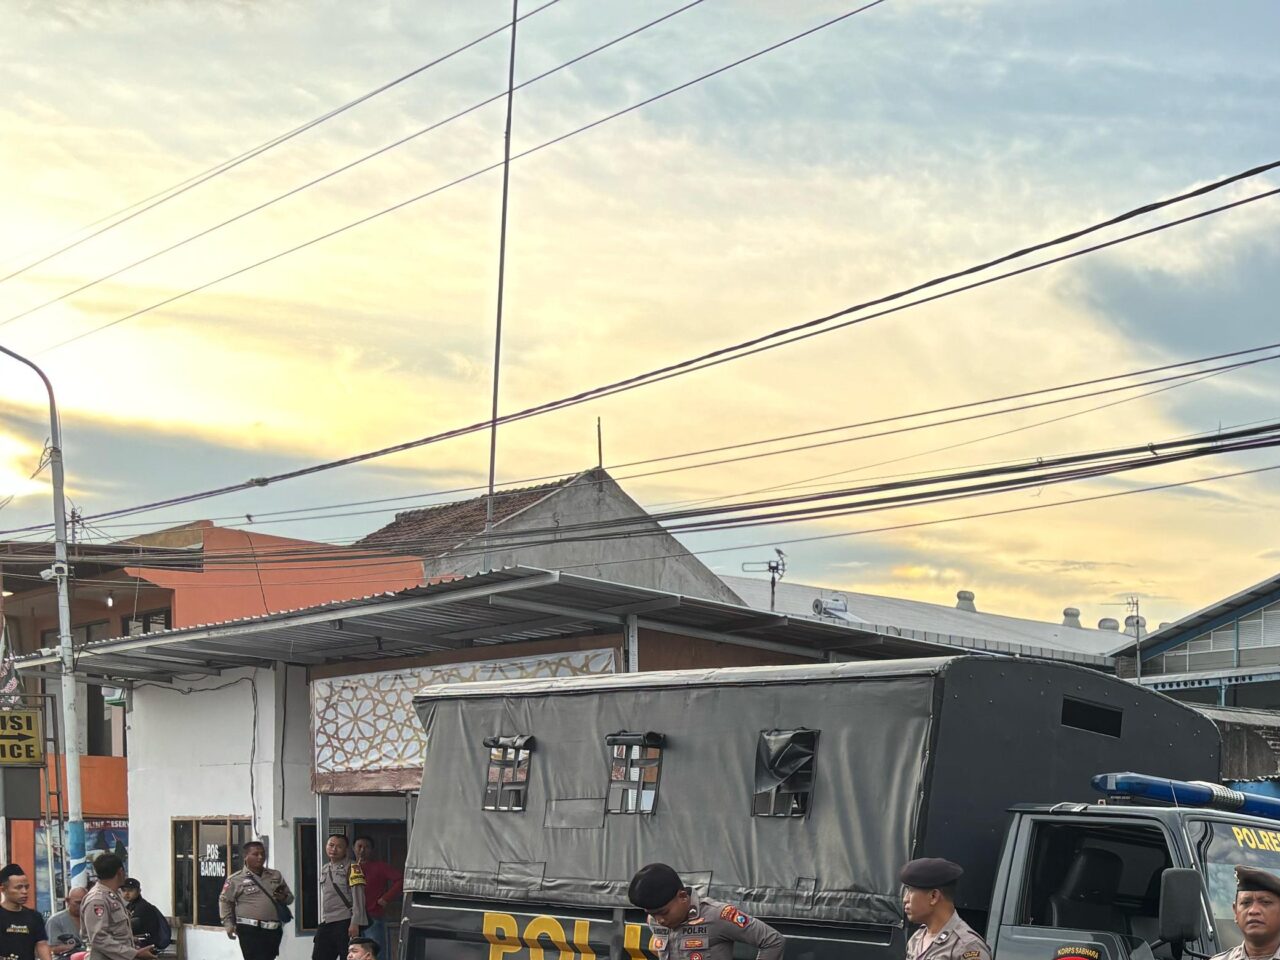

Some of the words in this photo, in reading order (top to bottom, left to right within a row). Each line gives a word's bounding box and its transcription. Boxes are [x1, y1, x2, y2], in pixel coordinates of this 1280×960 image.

[206, 844, 219, 860] POS
[200, 861, 226, 877] BARONG
[682, 926, 707, 935] POLRI
[1057, 947, 1075, 956] KORPS
